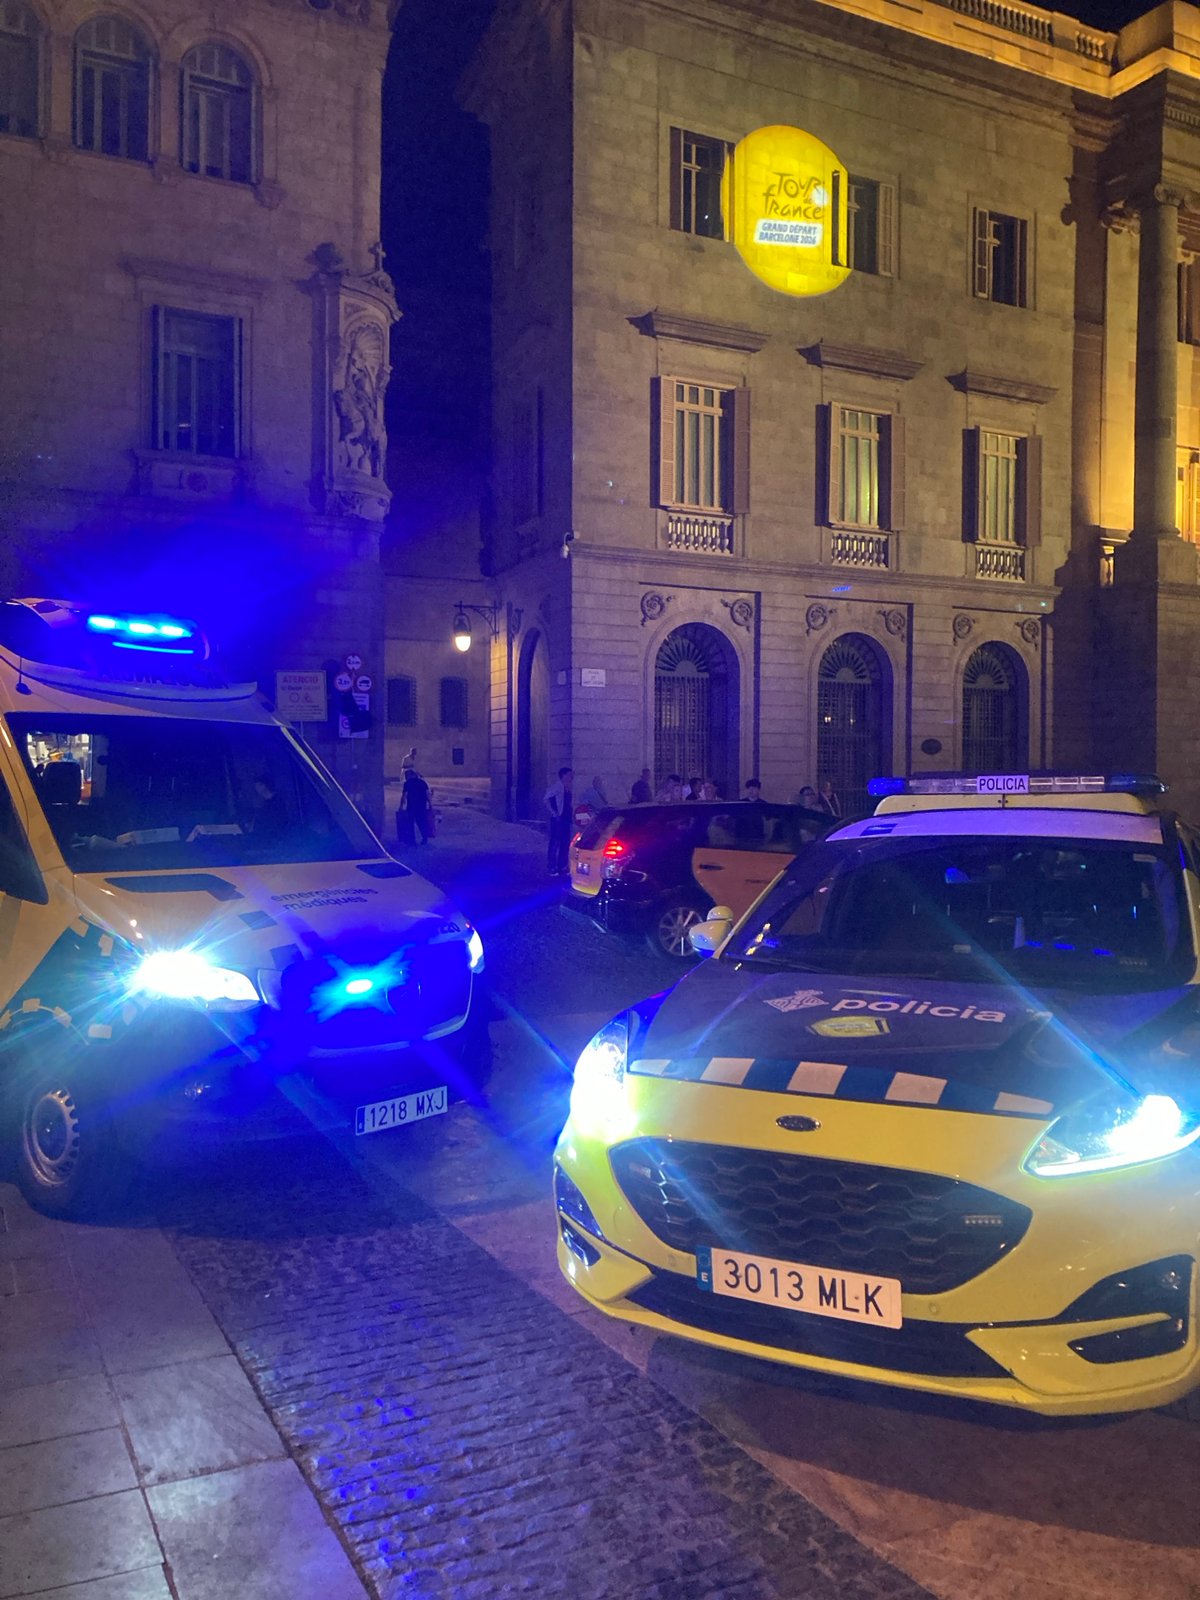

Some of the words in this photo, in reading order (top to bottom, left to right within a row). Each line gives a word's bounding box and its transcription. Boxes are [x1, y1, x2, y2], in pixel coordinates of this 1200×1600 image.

[762, 222, 788, 233] GRAND
[759, 232, 799, 243] BARCELONE
[800, 235, 817, 245] 2026
[979, 777, 1026, 791] POLICIA
[831, 999, 1007, 1023] policia
[370, 1100, 408, 1128] 1218
[416, 1090, 444, 1117] MXJ
[701, 1272, 709, 1283] E
[724, 1258, 804, 1302] 3013
[818, 1275, 884, 1318] MLK
